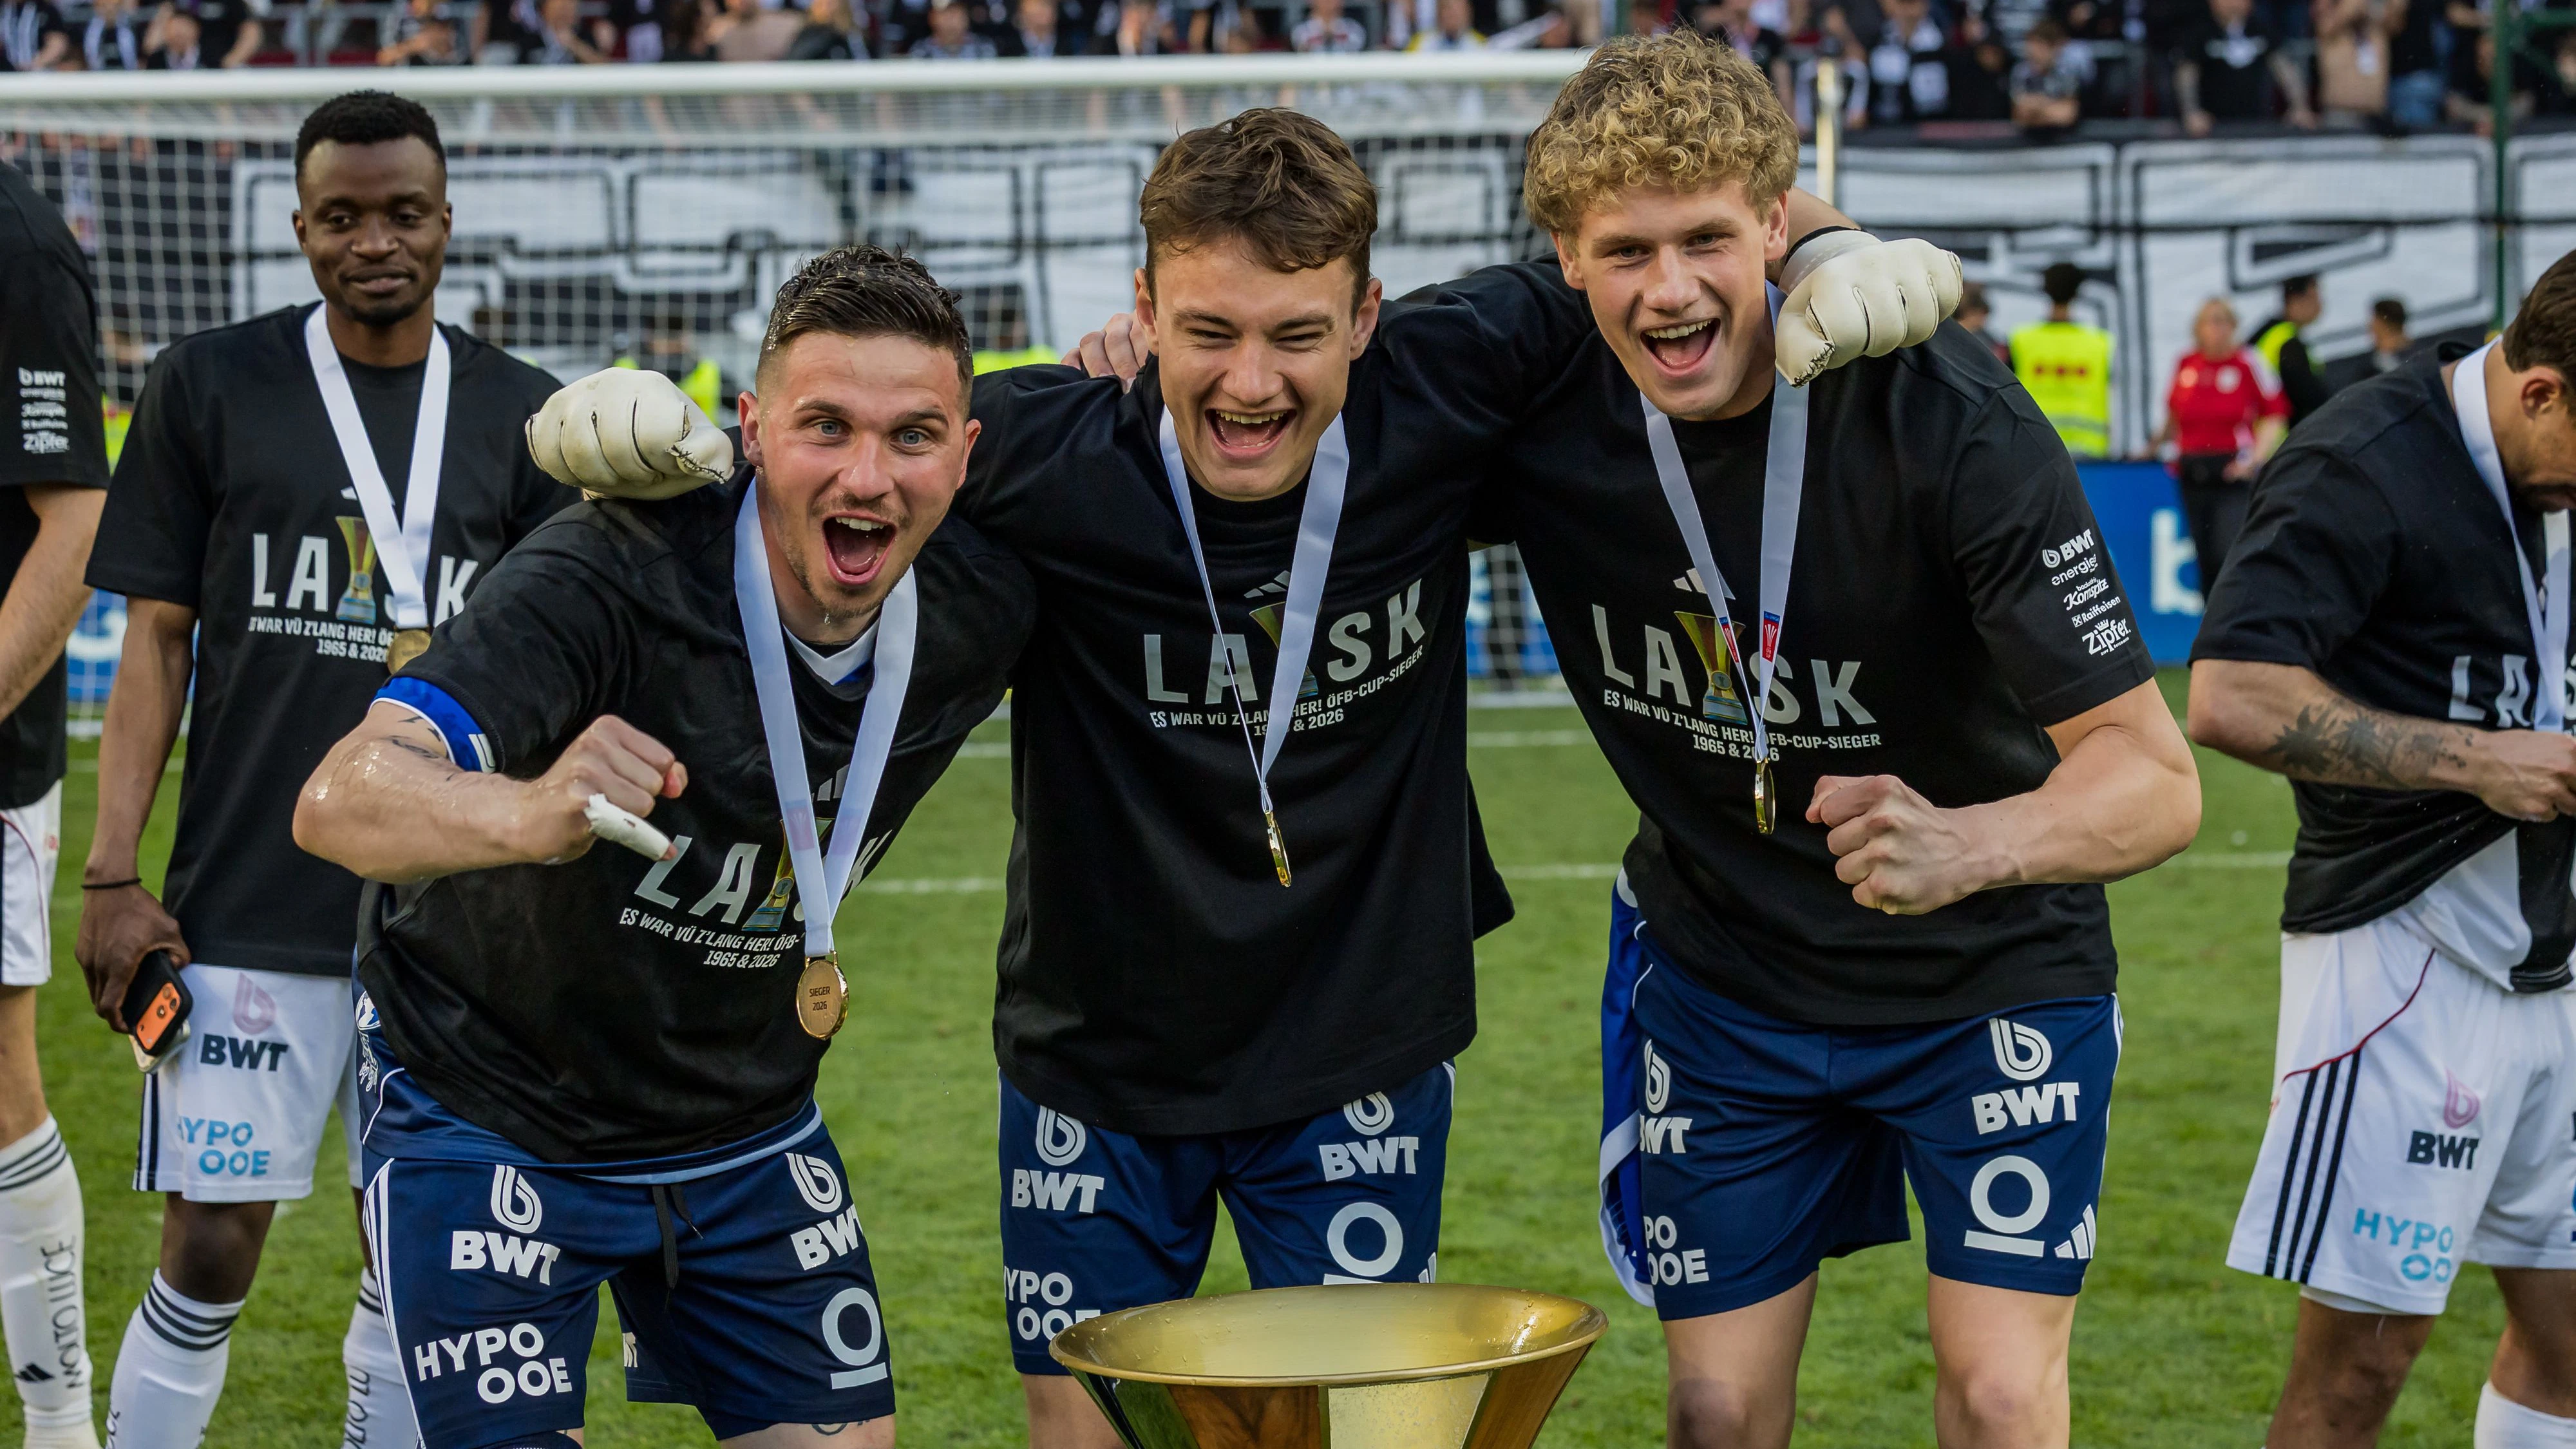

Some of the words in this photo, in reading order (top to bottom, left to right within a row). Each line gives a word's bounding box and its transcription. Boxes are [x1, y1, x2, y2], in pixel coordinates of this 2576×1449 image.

[2060, 529, 2094, 562] BWT
[252, 533, 478, 629] LAK
[2082, 596, 2121, 623] Raiffeisen
[316, 638, 346, 657] 1965
[348, 643, 359, 659] &
[348, 625, 375, 644] HER!
[1150, 711, 1167, 728] ES
[1170, 712, 1204, 726] WAR
[1206, 712, 1227, 725] VÜ
[1327, 645, 1423, 708] ÖFB-CUP-SIEGER
[1293, 719, 1305, 732] &
[1308, 708, 1344, 729] 2026
[1604, 689, 1620, 707] ES
[1623, 694, 1651, 717] WAR
[1651, 705, 1670, 723] VÜ
[1672, 712, 1718, 738] Z'LANG
[1721, 726, 1754, 744] HER!
[1693, 734, 1725, 755] 1965
[1728, 743, 1740, 758] &
[1743, 744, 1779, 762] 26
[620, 908, 639, 925] ES
[639, 913, 674, 937] WAR
[674, 925, 697, 942] VÜ
[694, 929, 744, 950] Z'LANG
[743, 936, 775, 952] HER!
[703, 950, 739, 967] 1965
[736, 954, 747, 969] &
[746, 954, 781, 969] 2026
[809, 986, 831, 997] SIEGER
[812, 1001, 828, 1011] 2026
[200, 1033, 289, 1072] BWT
[1971, 1082, 2079, 1135] BWT
[178, 1116, 253, 1147] YPO
[2407, 1130, 2479, 1170] BWT
[199, 1149, 270, 1177] OOE
[1319, 1136, 1419, 1182] BWT
[1012, 1169, 1104, 1213] BWT
[2353, 1208, 2453, 1253] HYPO
[451, 1231, 560, 1285] BWT
[1003, 1265, 1072, 1305] YPO
[415, 1323, 544, 1382] HYPO
[477, 1358, 573, 1403] OOE
